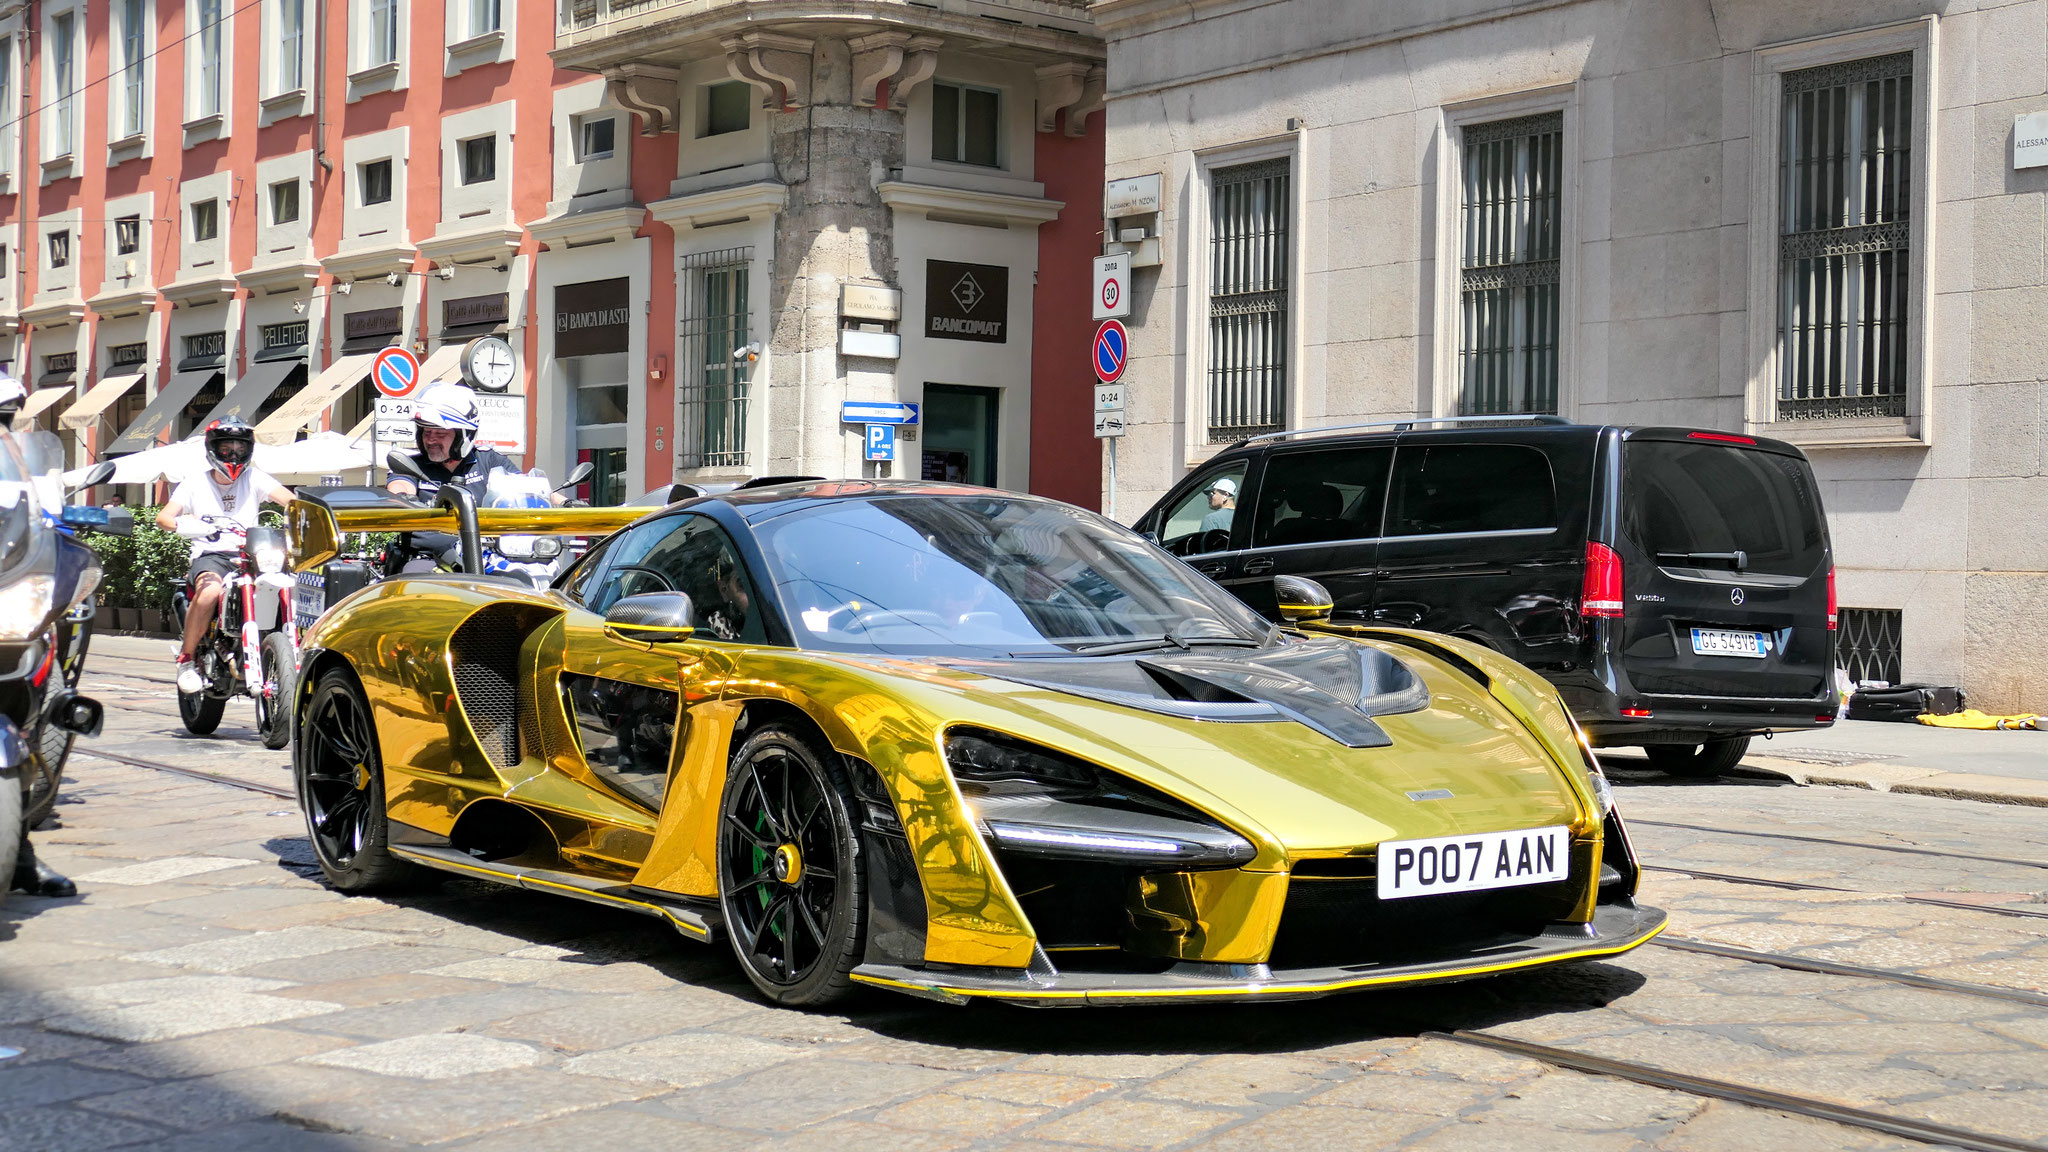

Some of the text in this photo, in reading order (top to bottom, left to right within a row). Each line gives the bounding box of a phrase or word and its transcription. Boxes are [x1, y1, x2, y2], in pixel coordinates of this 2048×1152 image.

[1104, 262, 1118, 271] zona
[1105, 287, 1116, 300] 30
[570, 307, 628, 329] BANCA DI ASTI
[931, 316, 1002, 336] BANCOMAT
[870, 426, 885, 449] P
[1701, 632, 1717, 649] GG
[1721, 633, 1757, 651] 549VB
[1495, 834, 1555, 879] AAN
